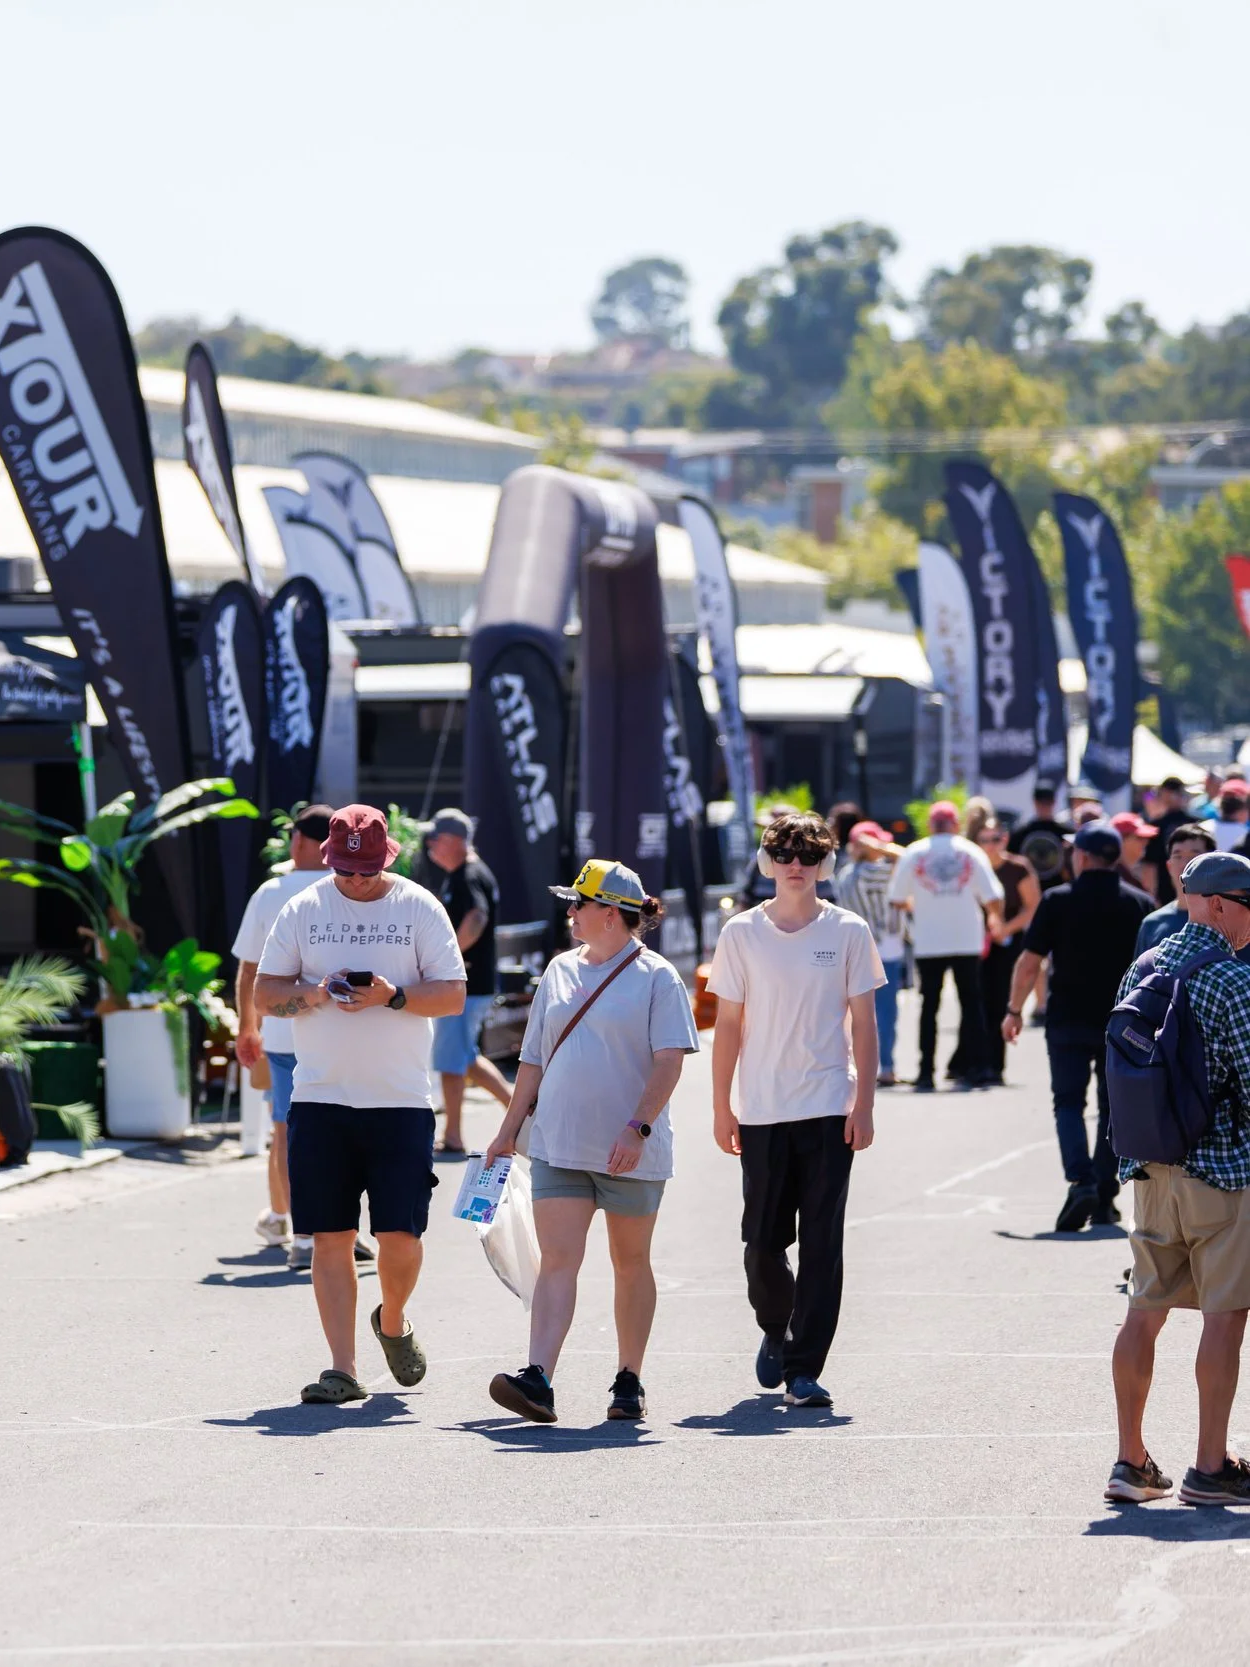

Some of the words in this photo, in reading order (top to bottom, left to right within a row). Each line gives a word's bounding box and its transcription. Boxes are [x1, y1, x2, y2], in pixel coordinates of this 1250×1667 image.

[2, 422, 69, 562] CARAVANS
[958, 482, 1015, 730] VICTORY
[309, 922, 351, 934] RED
[370, 924, 413, 935] HOT
[309, 933, 345, 945] CHILI
[350, 934, 412, 946] PEPPERS
